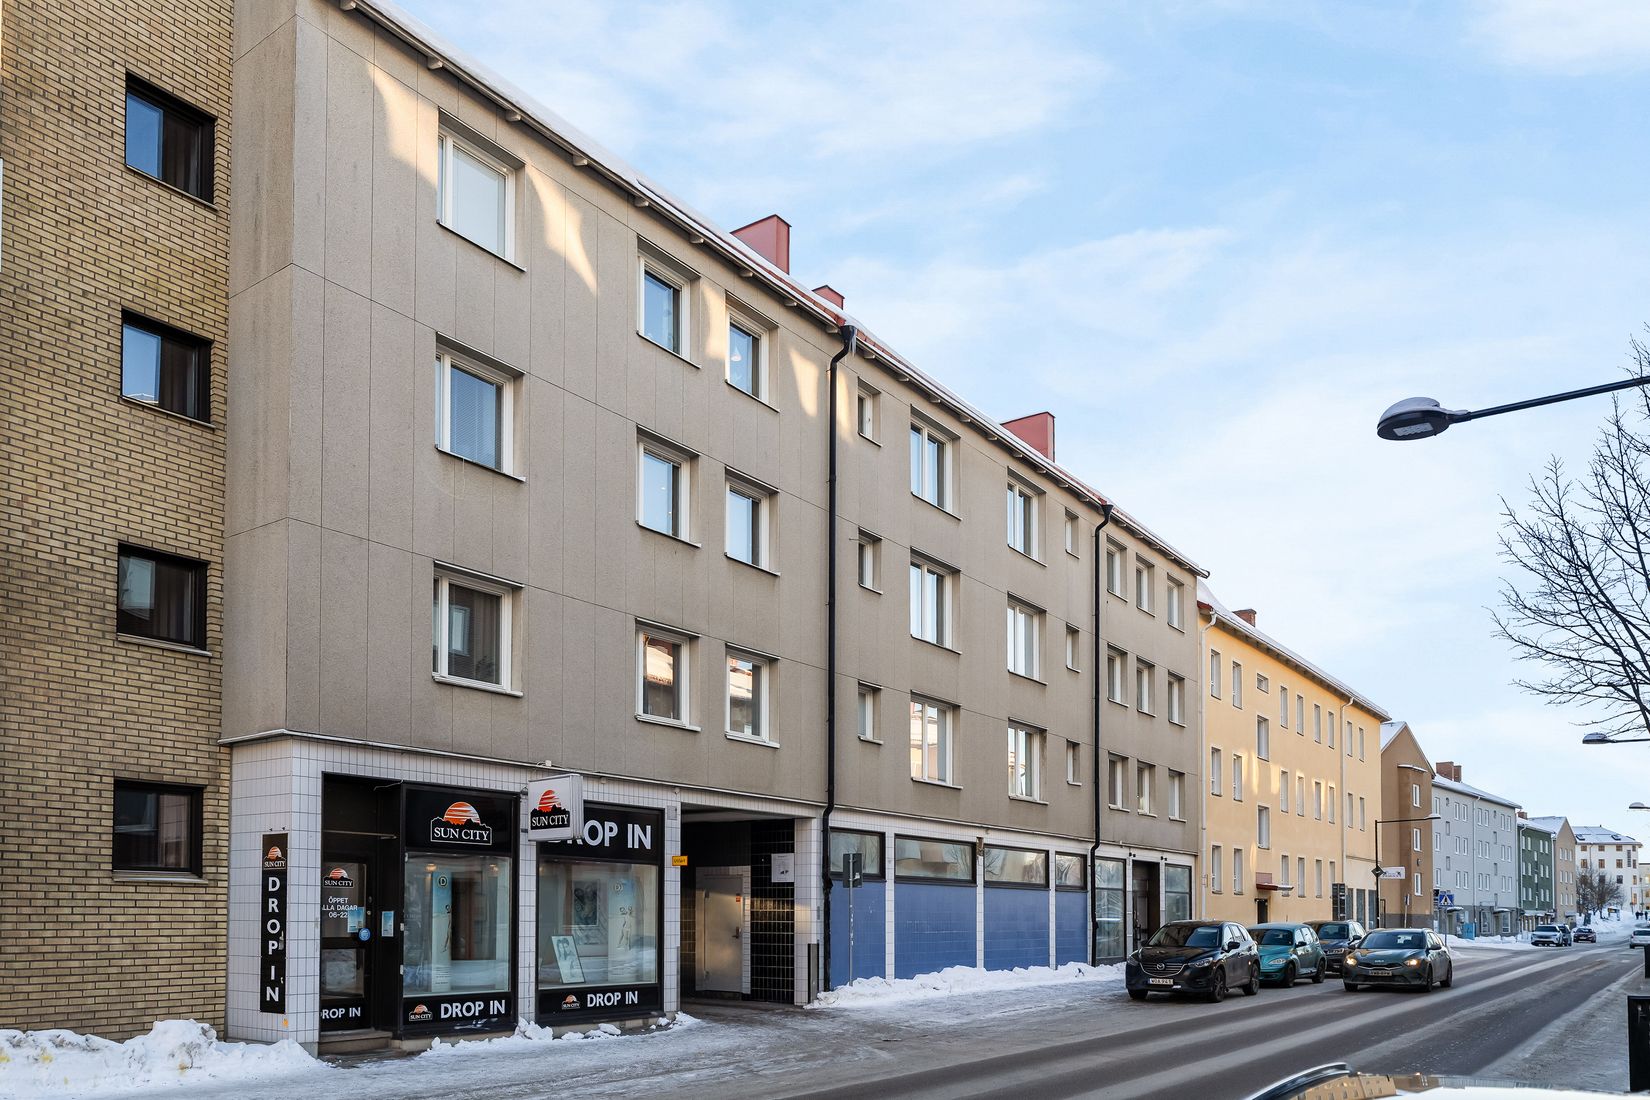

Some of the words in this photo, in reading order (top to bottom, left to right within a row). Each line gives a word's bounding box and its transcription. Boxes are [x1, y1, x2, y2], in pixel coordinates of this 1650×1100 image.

[531, 815, 548, 827] SUN
[549, 814, 569, 825] CITY
[434, 827, 459, 839] SUN
[461, 829, 489, 841] CITY
[627, 823, 652, 850] IN
[328, 895, 348, 904] ÖPPET
[587, 992, 622, 1008] DROP
[625, 991, 638, 1005] IN
[349, 1006, 361, 1018] IN
[440, 1001, 485, 1019] DROP
[489, 1000, 506, 1015] IN
